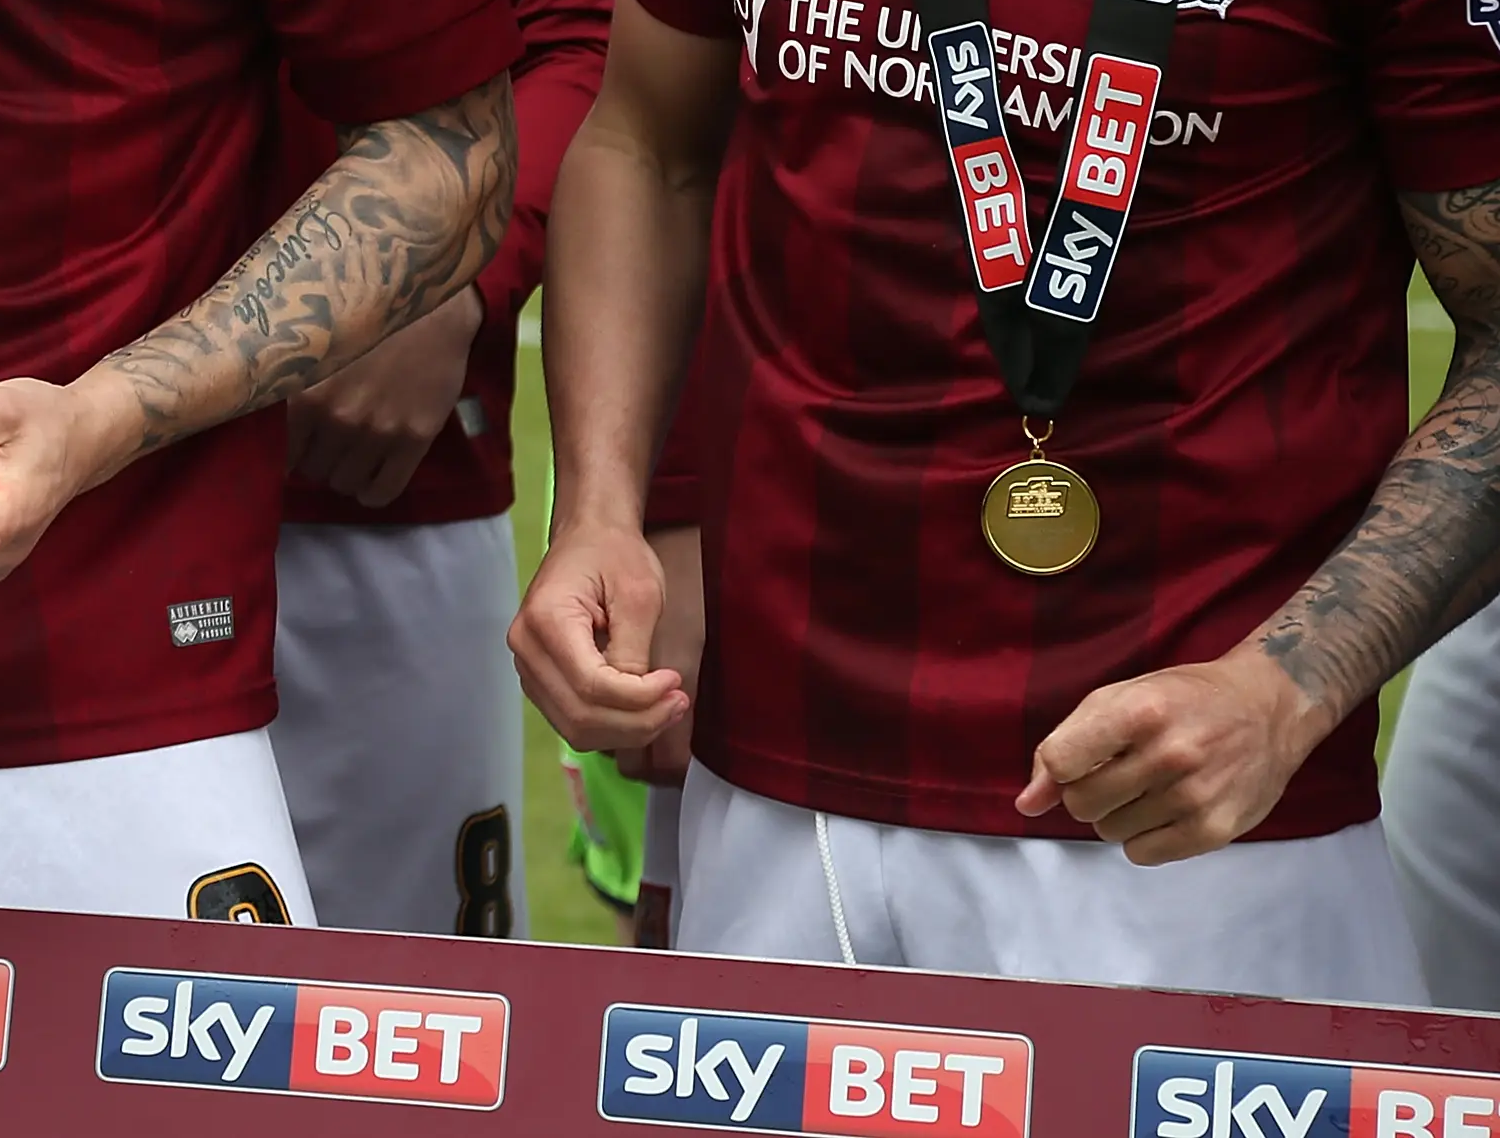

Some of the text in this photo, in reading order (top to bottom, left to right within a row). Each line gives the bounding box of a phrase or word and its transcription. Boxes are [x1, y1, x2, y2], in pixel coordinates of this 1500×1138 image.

[778, 39, 831, 84] OF
[946, 40, 1025, 267] sky BET
[1048, 73, 1144, 306] sky BET
[233, 199, 353, 337] Lincoln
[170, 599, 230, 620] AUTHENTIC
[121, 980, 482, 1084] sky BET
[624, 1017, 1004, 1127] sky BET
[1157, 1060, 1500, 1138] sky BE
